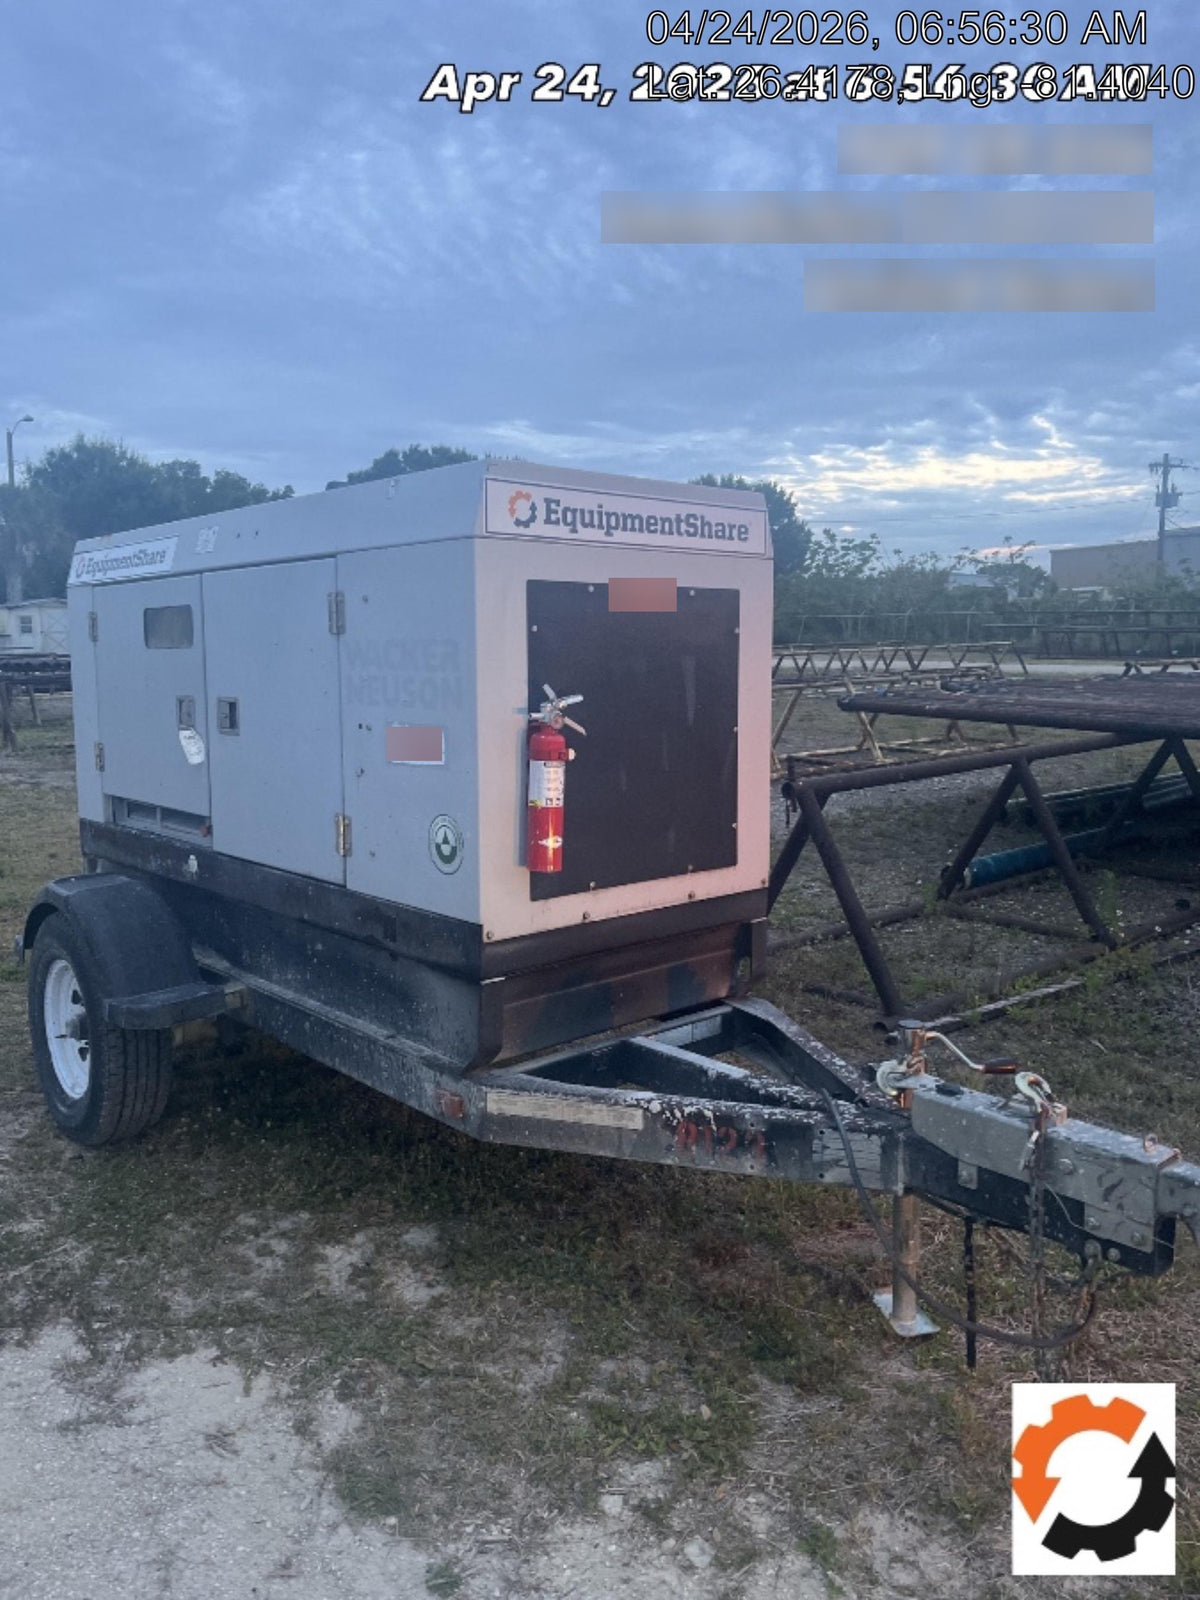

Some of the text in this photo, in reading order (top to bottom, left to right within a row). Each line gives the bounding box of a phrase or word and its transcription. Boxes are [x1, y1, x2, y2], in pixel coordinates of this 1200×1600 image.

[543, 497, 750, 542] EquipmentShare
[85, 549, 166, 577] EquipmentShare
[345, 637, 461, 672] WACKER
[345, 674, 464, 711] NEUSON
